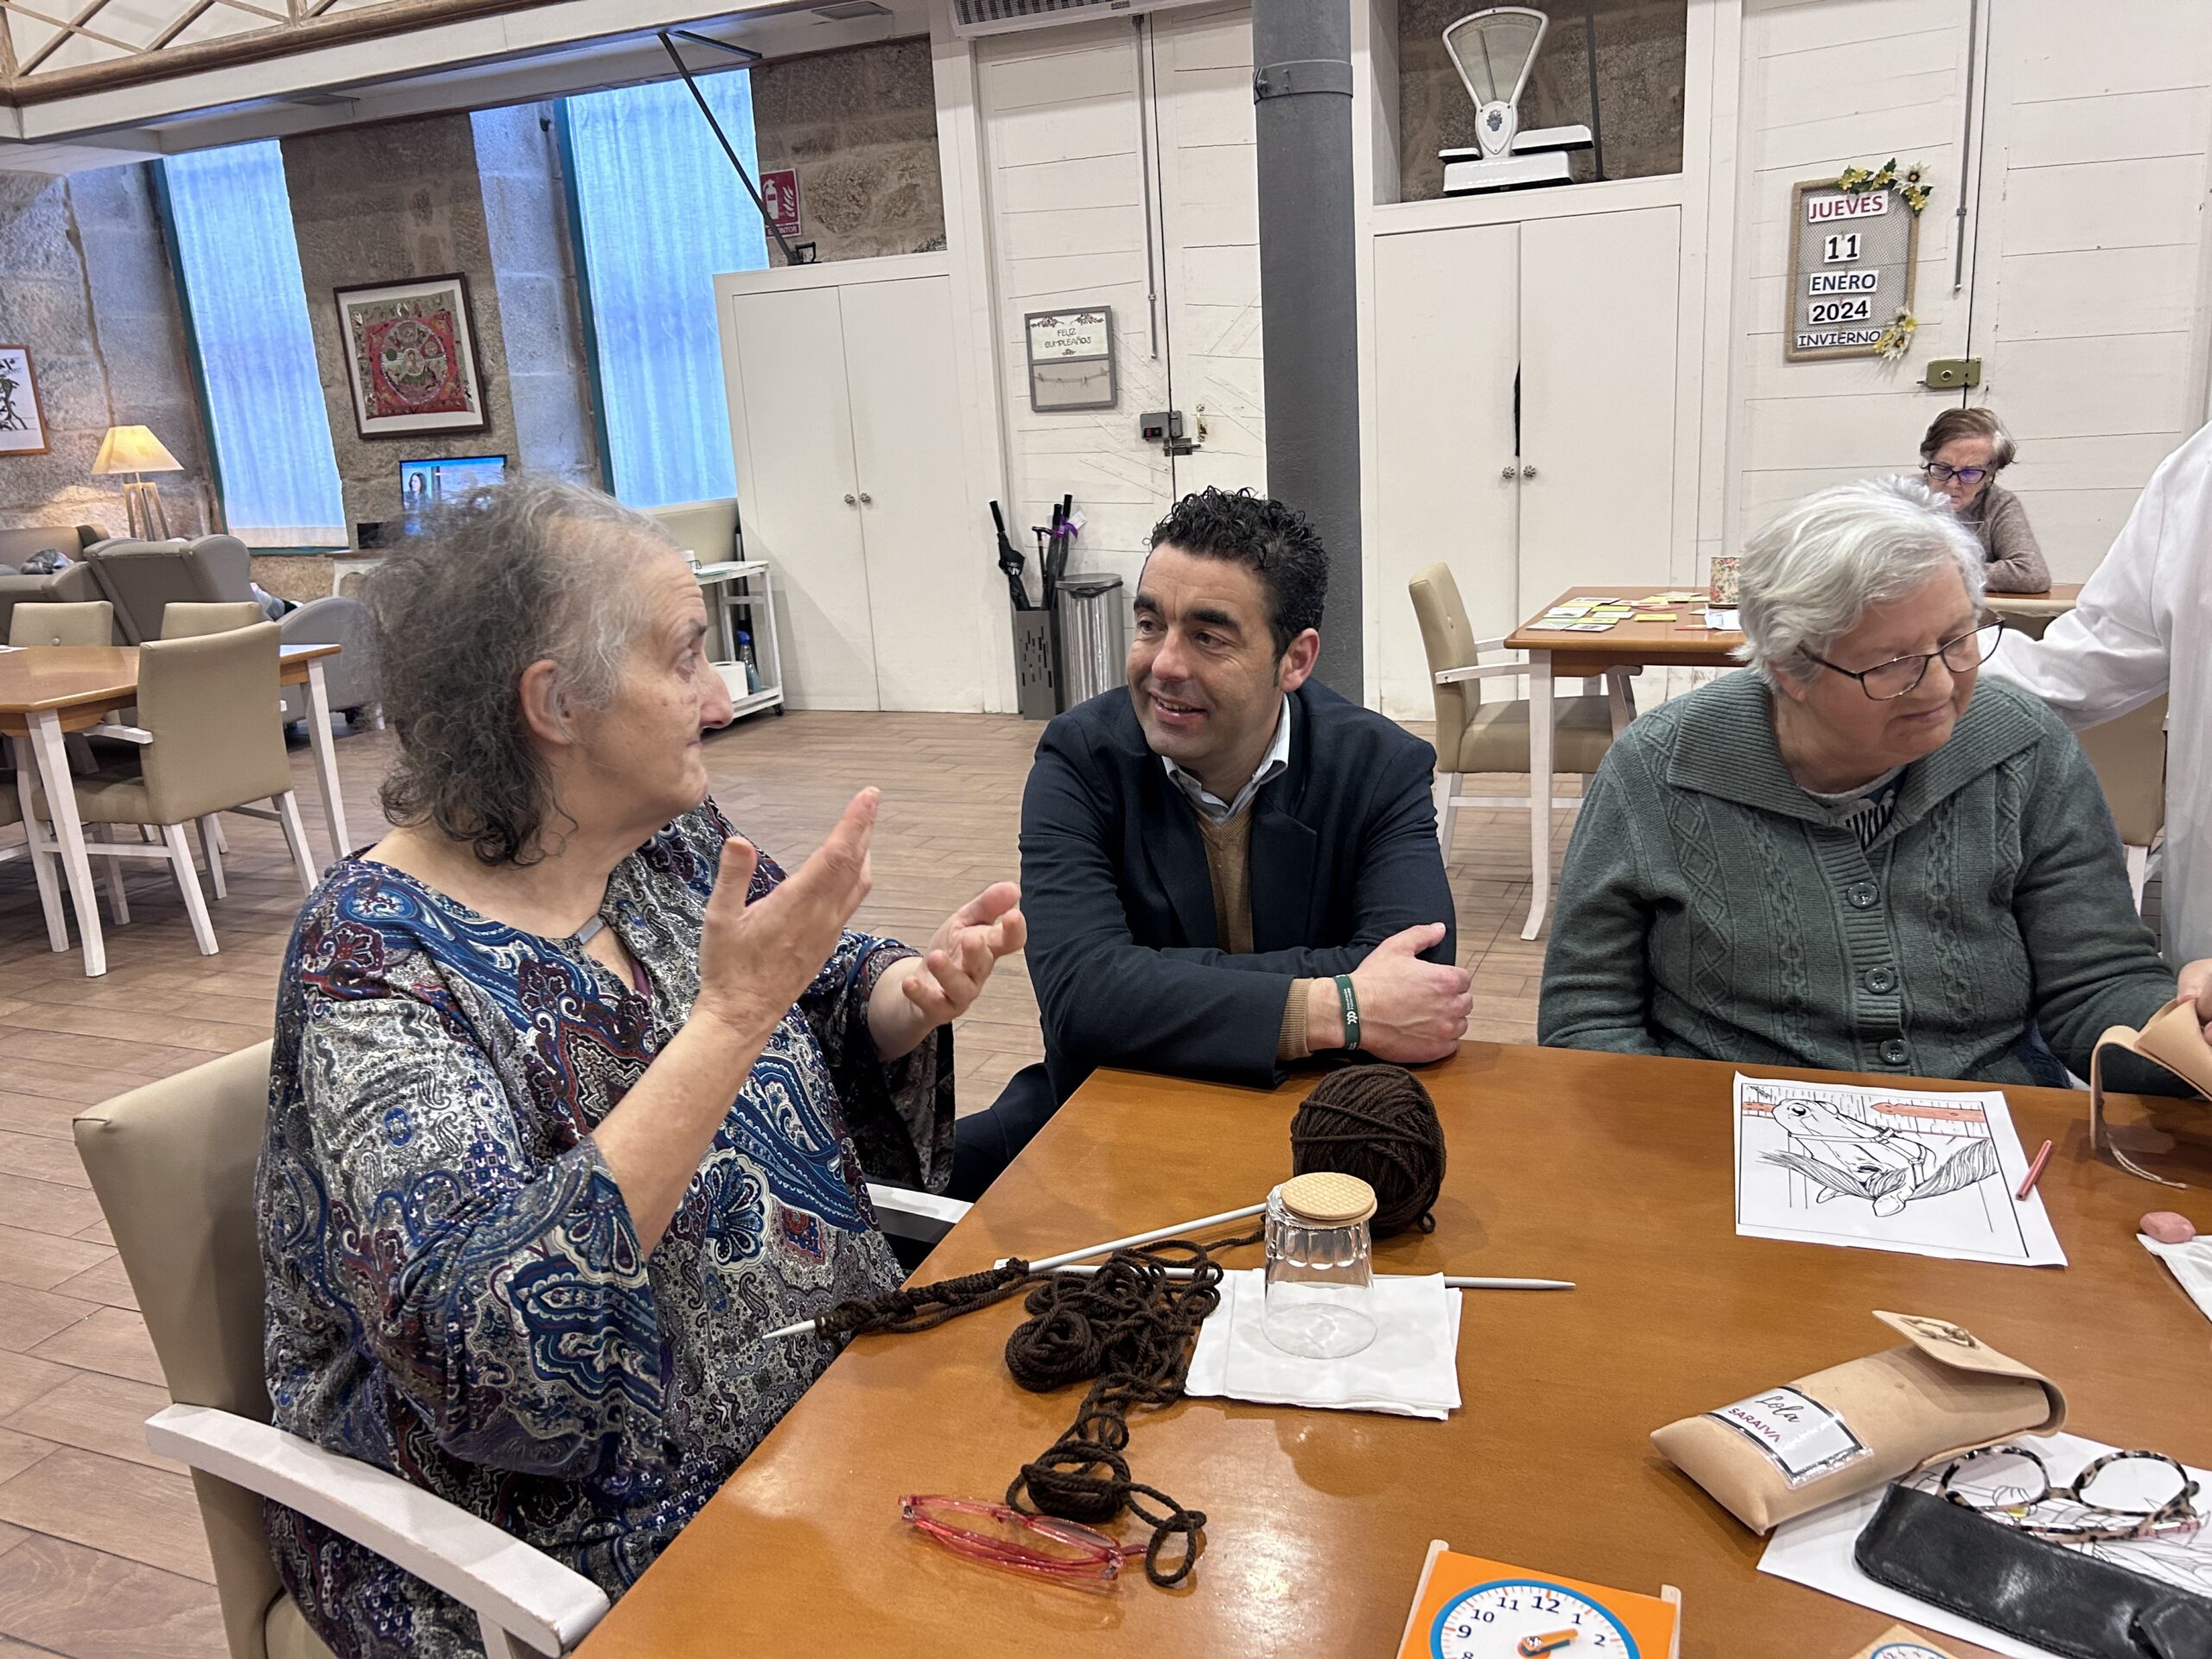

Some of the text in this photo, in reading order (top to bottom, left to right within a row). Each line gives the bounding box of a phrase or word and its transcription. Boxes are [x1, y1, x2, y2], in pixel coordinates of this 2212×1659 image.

[1810, 195, 1883, 219] JUEVES
[1827, 234, 1859, 259] 11
[1811, 274, 1876, 291] ENERO
[1812, 300, 1869, 322] 2024
[1057, 327, 1077, 337] FELIZ
[1798, 330, 1881, 346] INVIERNO
[1754, 1395, 1804, 1423] Lola
[1728, 1407, 1782, 1443] SARAIVA
[1496, 1597, 1520, 1611] 11
[1530, 1595, 1560, 1614] 12
[1470, 1609, 1496, 1623] 10
[1571, 1613, 1582, 1625] 1
[1457, 1624, 1472, 1638] 9
[1593, 1634, 1606, 1647] 2
